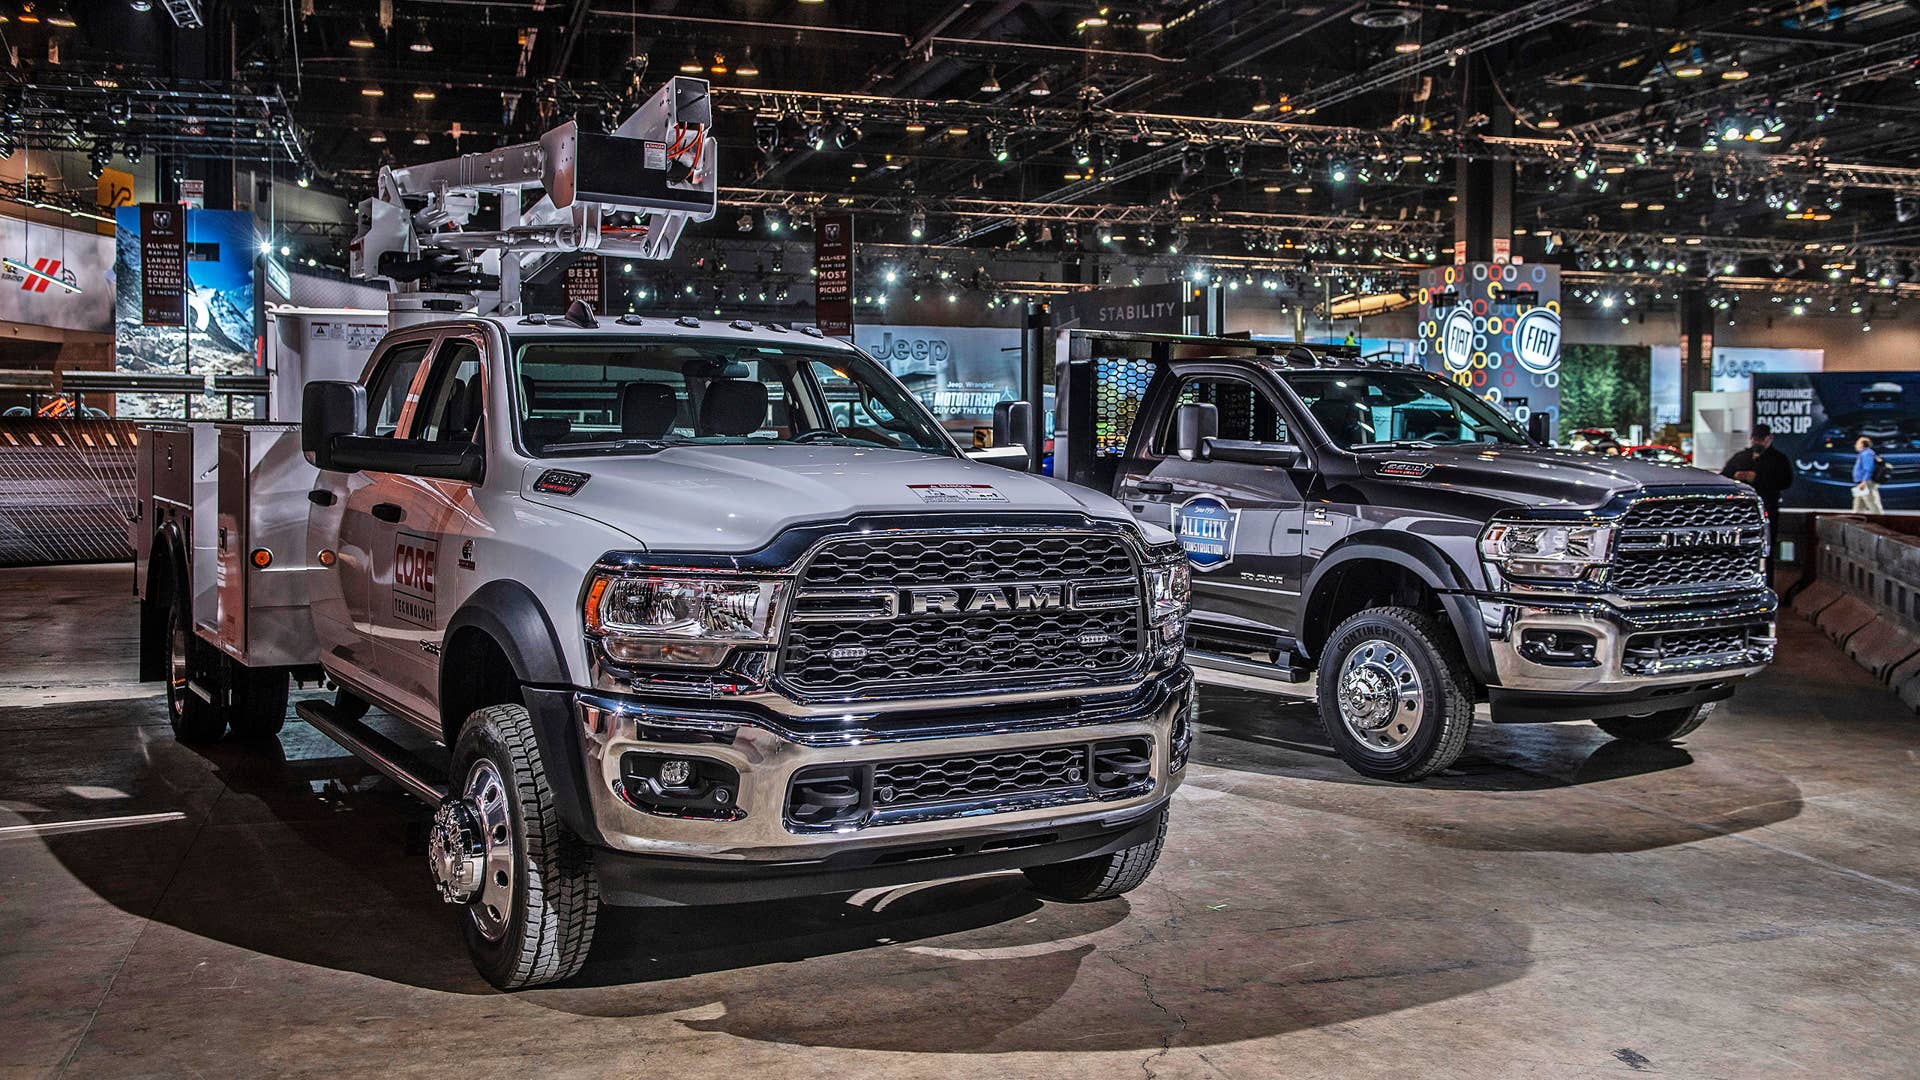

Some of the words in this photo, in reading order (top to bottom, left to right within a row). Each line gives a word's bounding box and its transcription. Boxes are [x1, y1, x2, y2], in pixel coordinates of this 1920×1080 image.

[568, 268, 599, 277] BEST
[820, 270, 847, 279] MOST
[1099, 302, 1176, 322] STABILITY
[870, 332, 951, 366] Jeep
[1450, 326, 1471, 357] FIAT
[1525, 325, 1557, 357] FIAT
[947, 380, 962, 389] Jeep
[1757, 387, 1812, 399] PERFORMANCE
[934, 391, 1001, 407] MOTORTREND
[1756, 400, 1779, 416] YOU
[1780, 400, 1812, 416] CAN'T
[933, 406, 949, 415] SUV
[950, 406, 961, 414] OF
[962, 406, 977, 414] THE
[978, 406, 994, 415] YEA
[1793, 415, 1812, 434] UP
[1180, 515, 1200, 536] ALL
[1202, 519, 1228, 540] CITY
[1672, 529, 1741, 546] RAM
[1183, 541, 1224, 555] CONSTRUCTION
[394, 543, 435, 593] CORE
[911, 585, 1062, 615] RAM
[394, 598, 434, 624] TECHNOLOGY
[1337, 625, 1408, 651] CONTINENTAL
